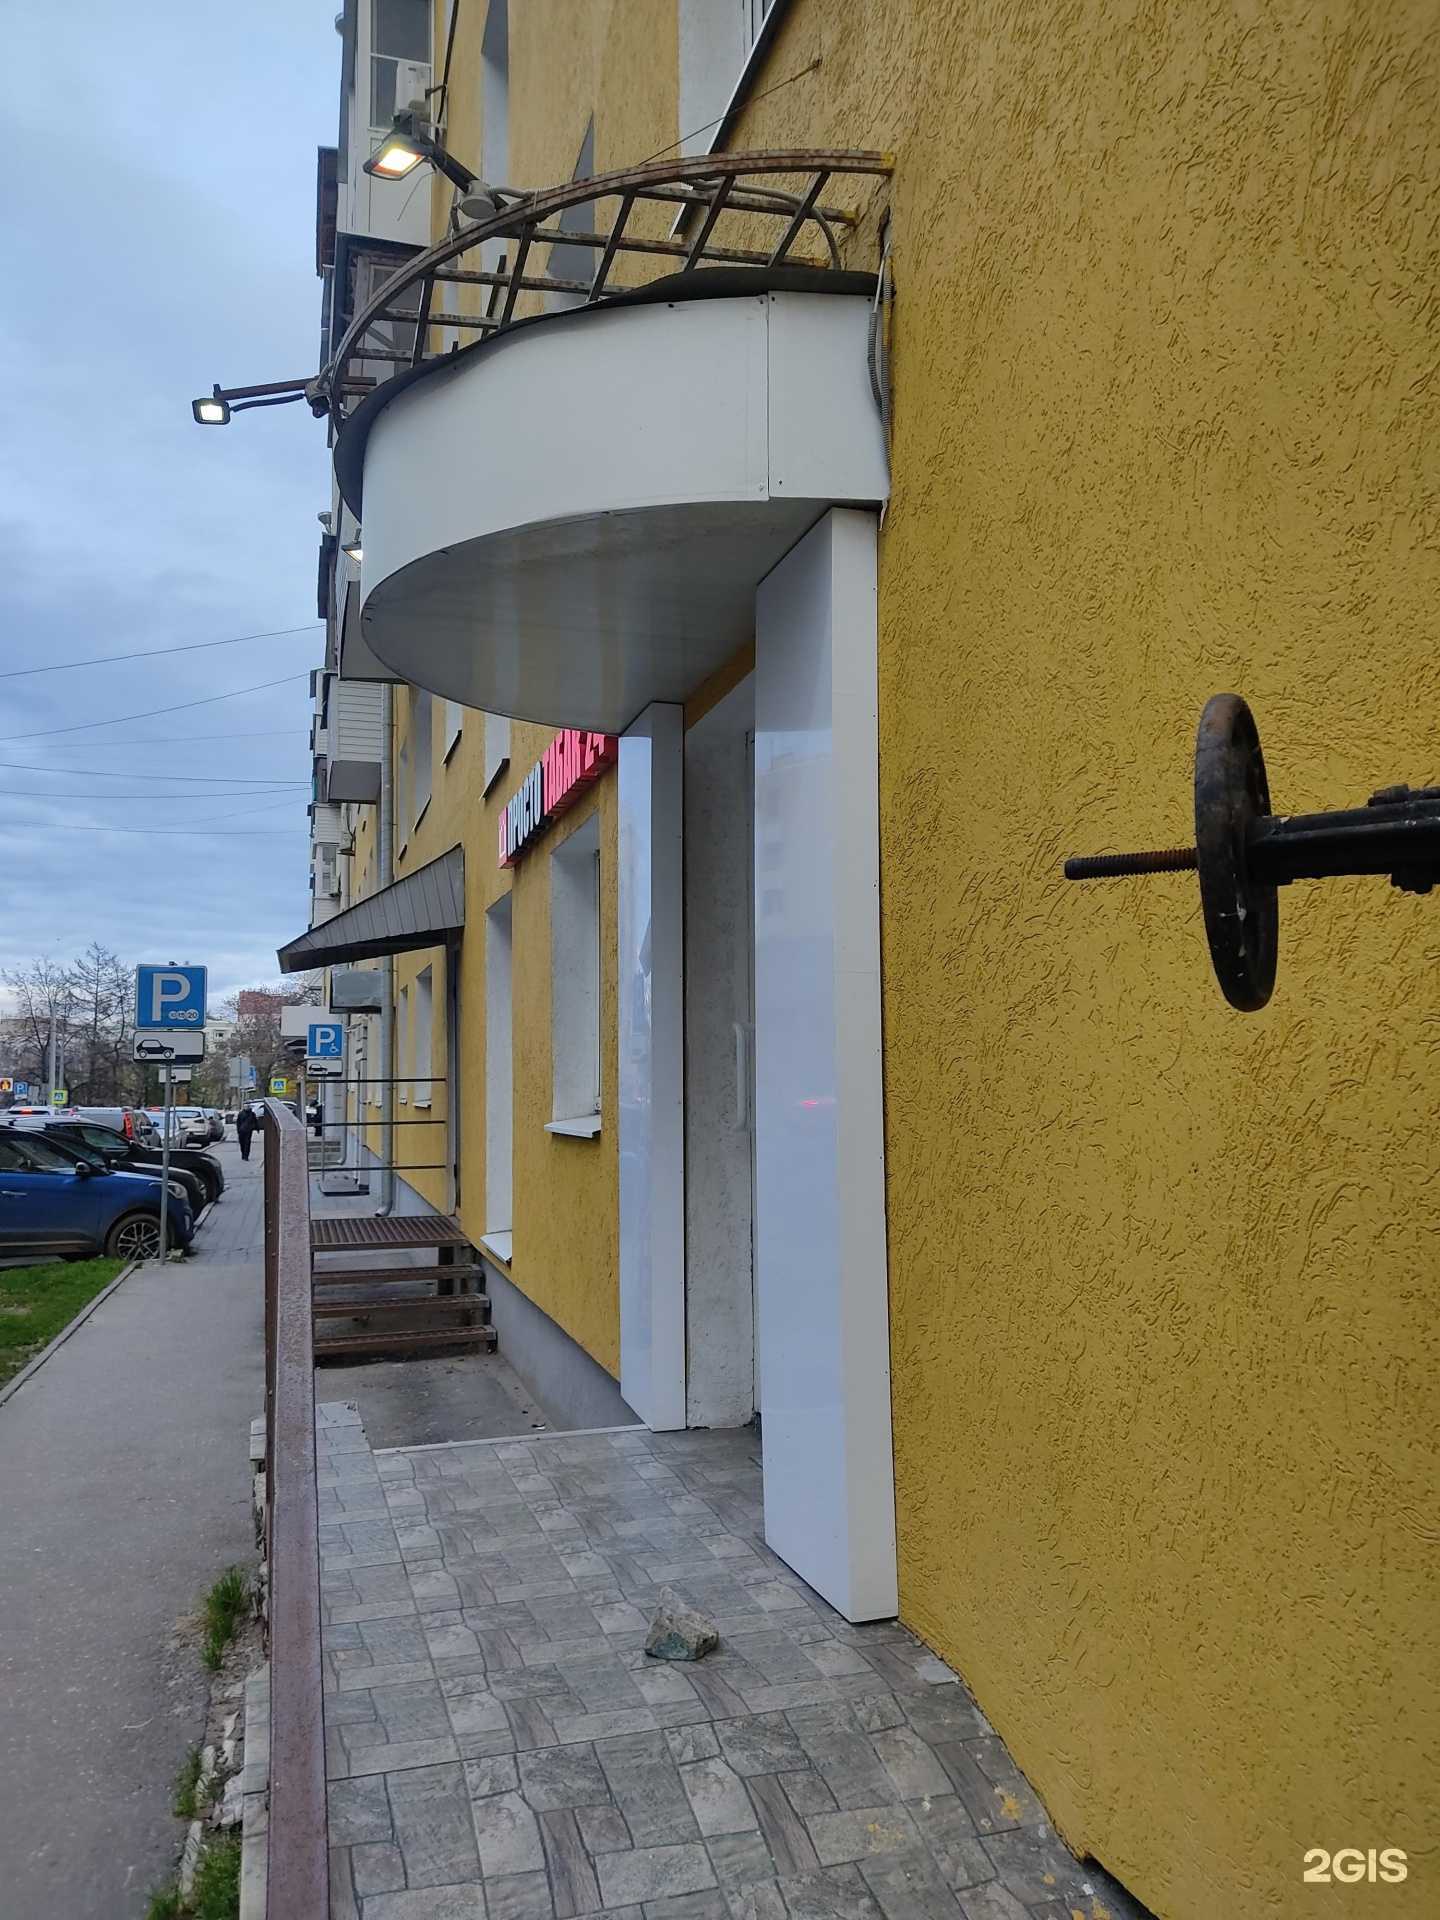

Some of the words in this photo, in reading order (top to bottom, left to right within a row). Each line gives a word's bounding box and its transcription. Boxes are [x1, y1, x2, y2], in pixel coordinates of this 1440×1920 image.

[508, 760, 542, 857] ПРОСТО
[542, 729, 581, 816] ТАБАК
[152, 973, 190, 1021] P
[315, 1027, 335, 1053] P
